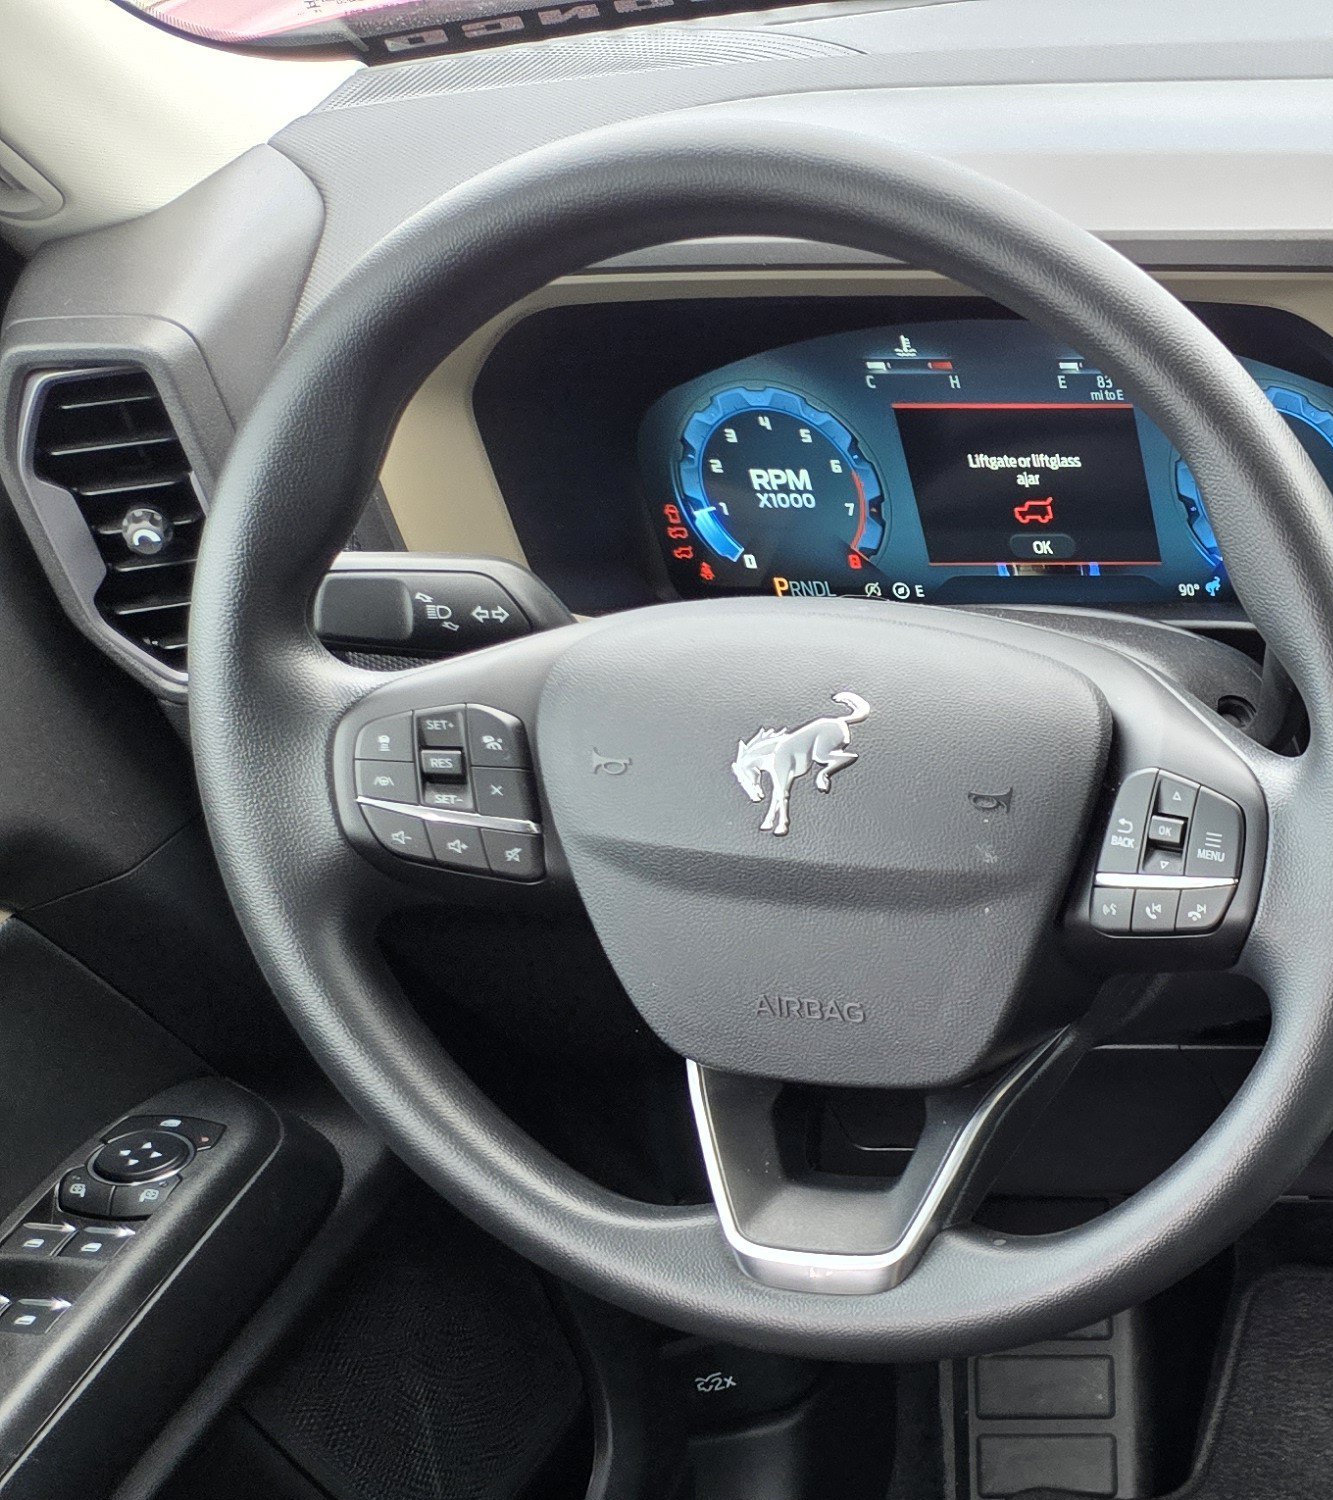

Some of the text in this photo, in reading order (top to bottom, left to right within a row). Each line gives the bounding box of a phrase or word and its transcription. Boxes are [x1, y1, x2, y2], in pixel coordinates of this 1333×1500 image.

[866, 376, 876, 389] C
[950, 376, 961, 389] H
[1057, 375, 1068, 389] E
[1104, 389, 1115, 401] to
[1116, 389, 1125, 401] E
[758, 415, 772, 431] 4
[724, 428, 738, 443] 3
[800, 428, 812, 443] 5
[709, 459, 724, 473] 2
[829, 459, 842, 473] 6
[967, 453, 1082, 471] Liftgate or liftglass
[749, 468, 813, 491] RPM
[1016, 471, 1040, 488] ajar
[757, 492, 816, 509] X1000
[844, 502, 855, 516] 7
[1032, 540, 1053, 555] OK
[915, 585, 925, 597] E
[430, 758, 453, 769] RES
[1158, 825, 1172, 837] OK
[1111, 835, 1135, 849] BACK
[1197, 848, 1225, 863] MENU
[755, 995, 868, 1024] AIRBAG
